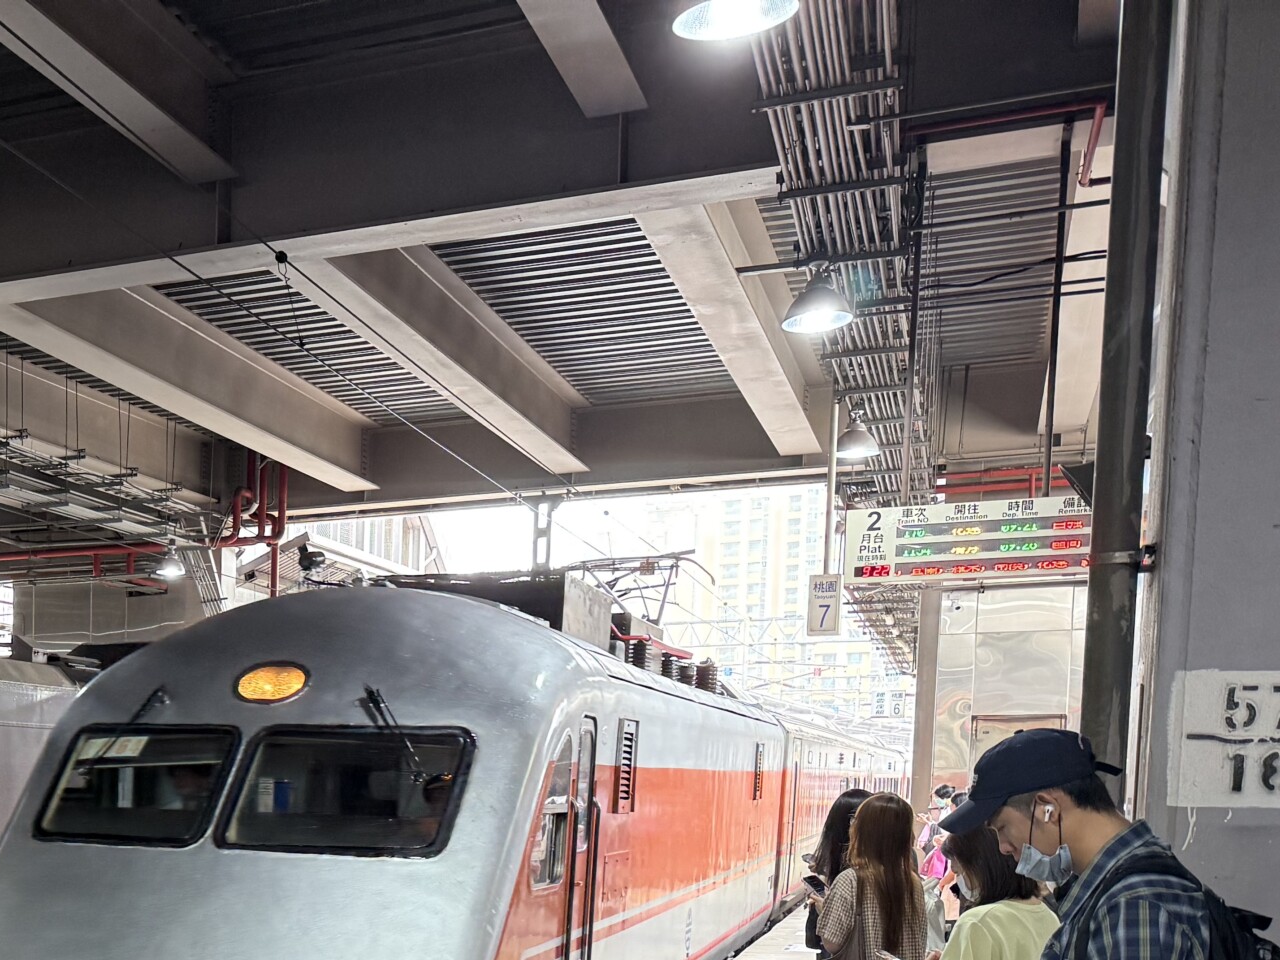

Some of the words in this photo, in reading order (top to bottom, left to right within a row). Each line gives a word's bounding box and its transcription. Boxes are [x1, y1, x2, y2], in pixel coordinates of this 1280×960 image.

[901, 507, 927, 518] 車次
[954, 503, 979, 515] 開往
[1008, 500, 1033, 512] 時間
[867, 511, 881, 531] 2
[945, 514, 988, 522] Destination
[861, 533, 884, 544] 月台
[859, 545, 885, 554] Plat.
[813, 581, 837, 593] 桃園
[819, 604, 831, 628] 7
[893, 703, 901, 715] 6
